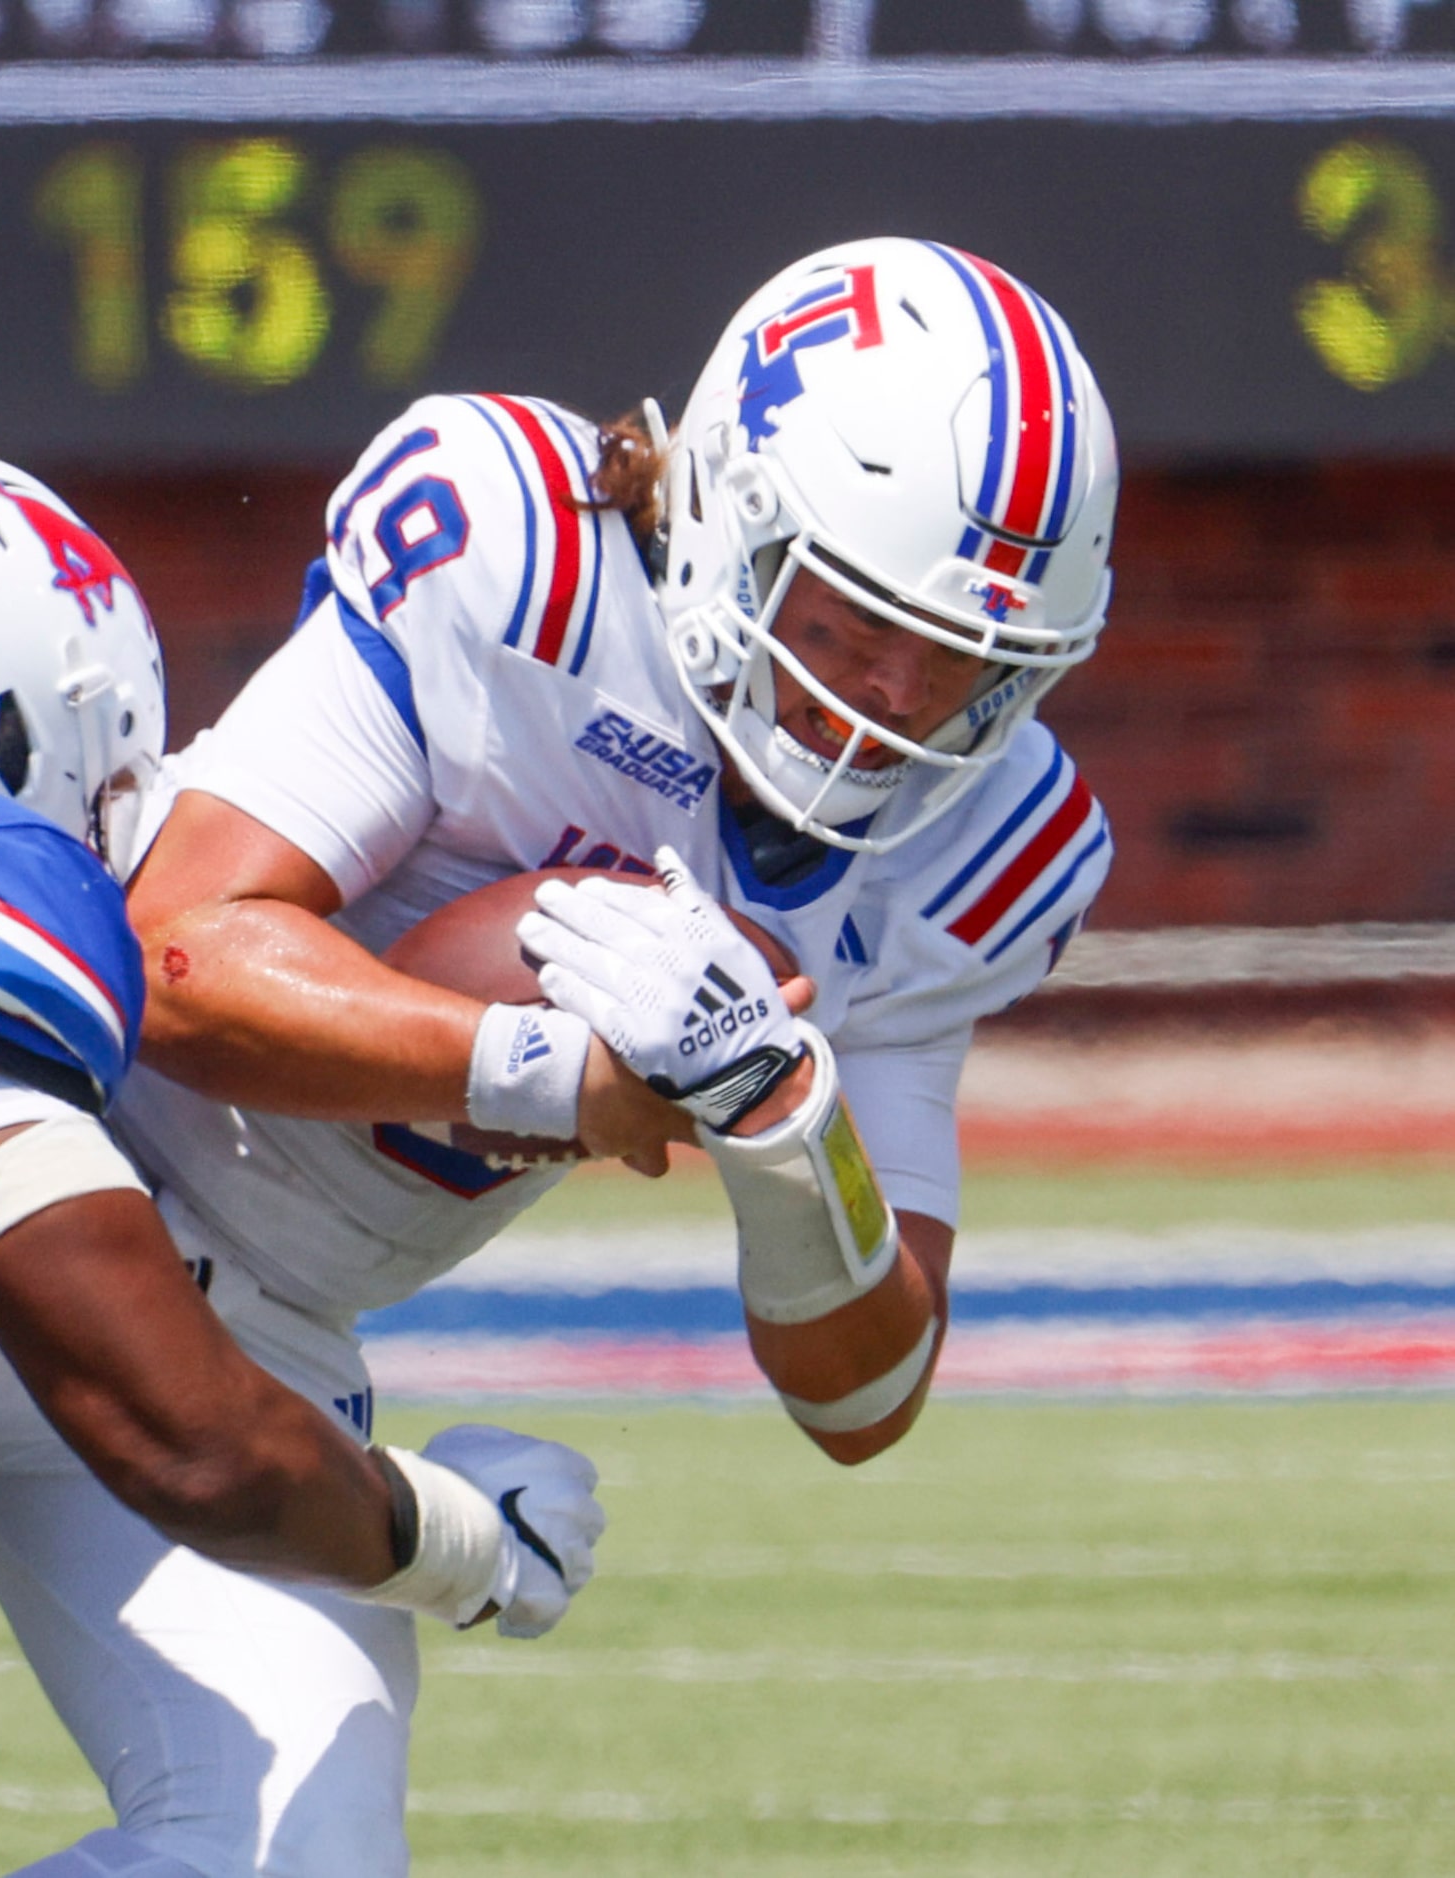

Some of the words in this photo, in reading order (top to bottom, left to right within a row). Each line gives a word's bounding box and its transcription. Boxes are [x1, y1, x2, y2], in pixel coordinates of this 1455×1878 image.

[326, 426, 471, 623] 19
[573, 733, 700, 811] GRADUATE
[507, 1012, 533, 1075] adidas
[678, 998, 769, 1057] adidas
